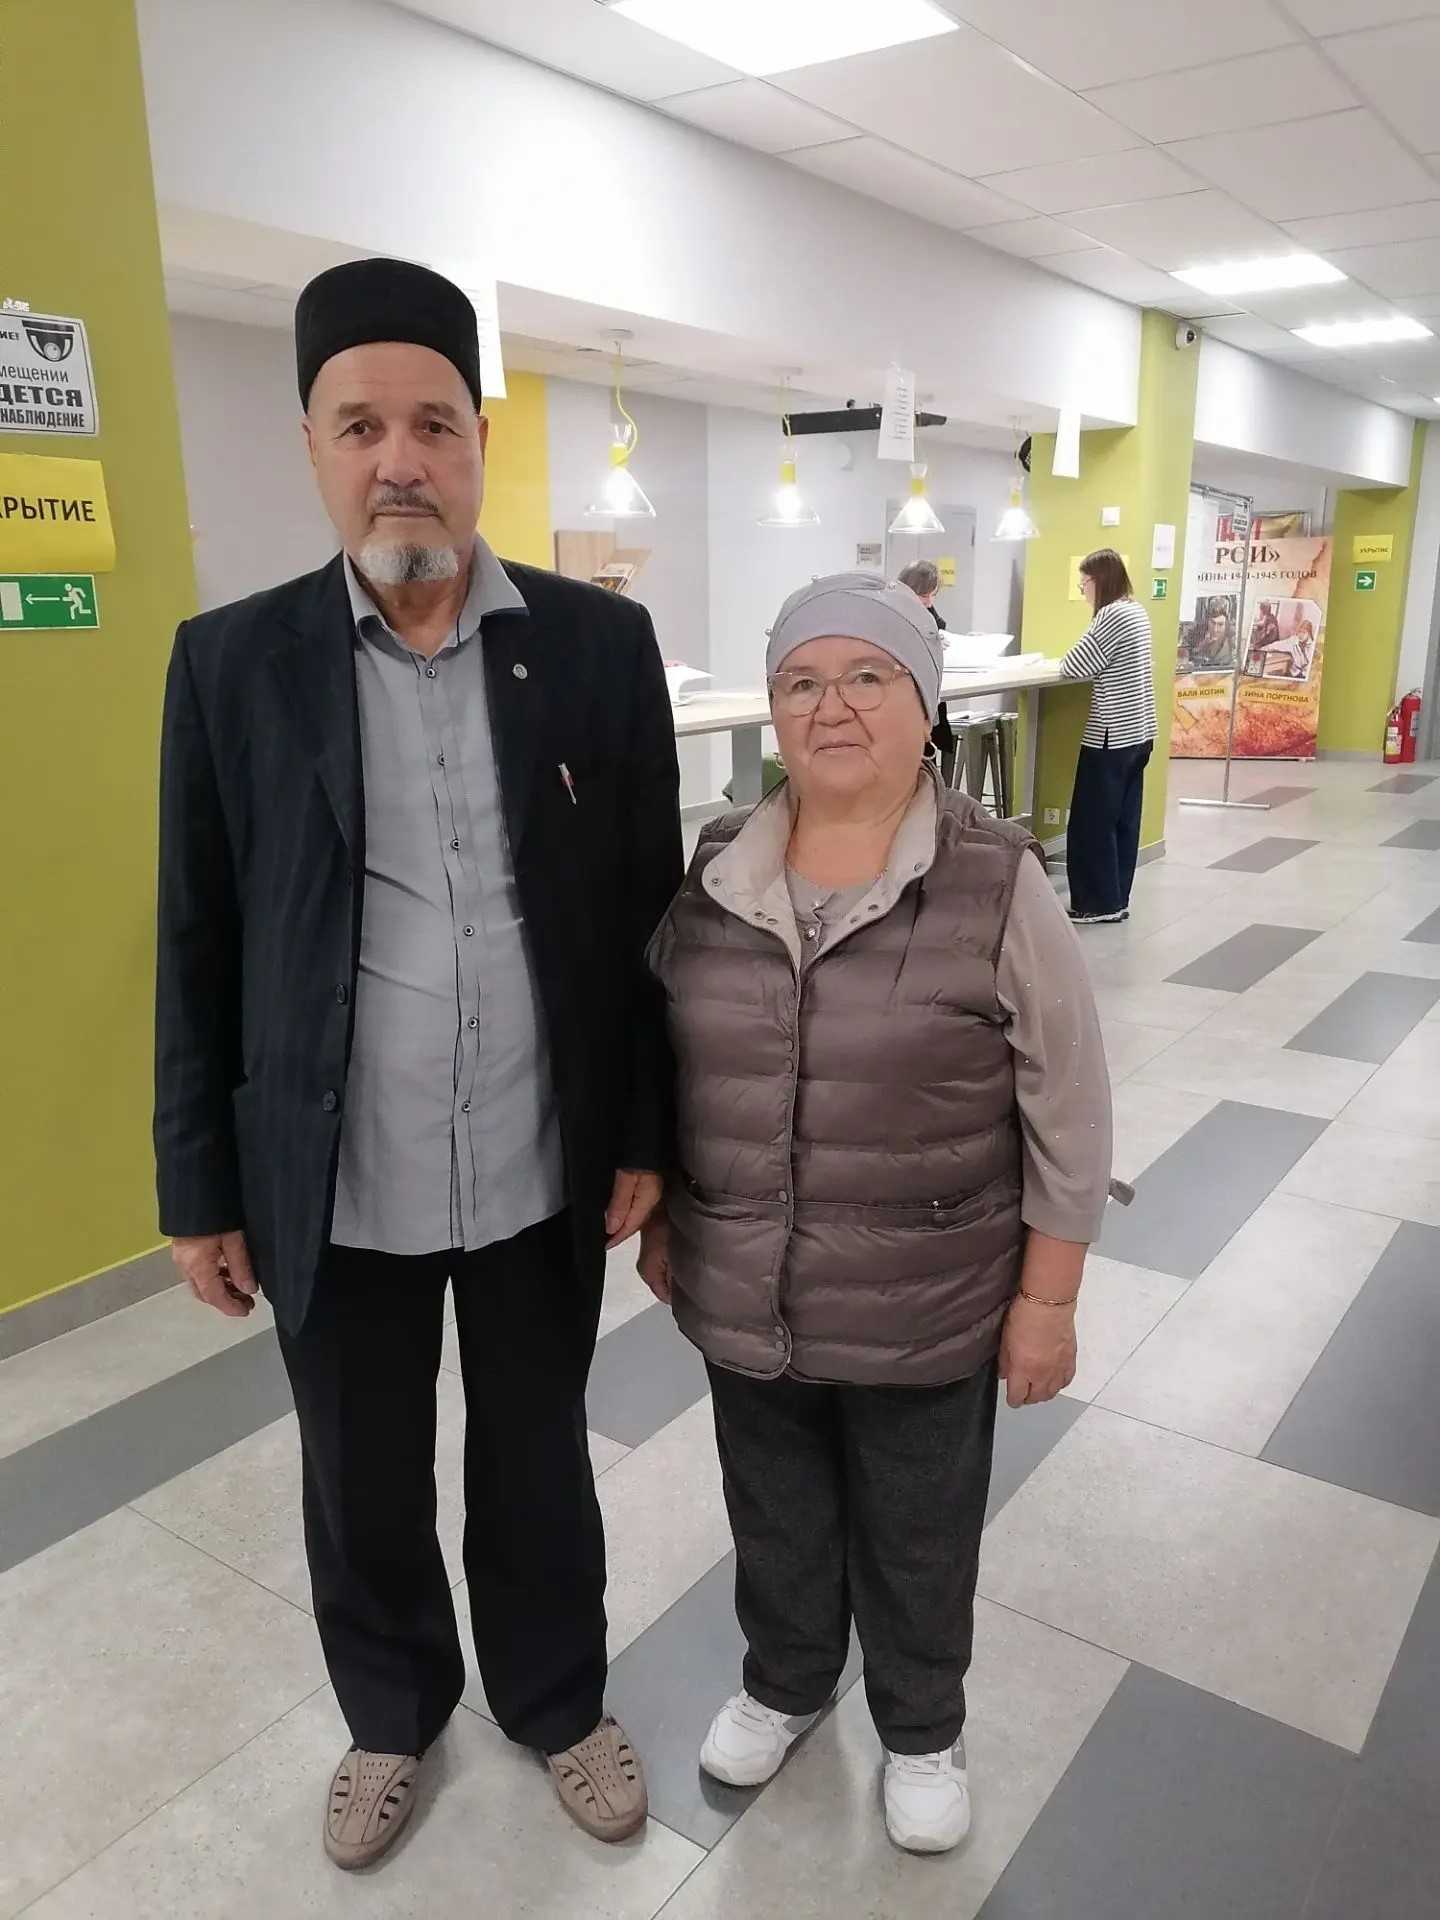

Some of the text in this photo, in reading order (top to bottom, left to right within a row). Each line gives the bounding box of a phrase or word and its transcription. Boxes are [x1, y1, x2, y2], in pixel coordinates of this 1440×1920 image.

[0, 383, 84, 408] ДЕТСЯ
[0, 408, 85, 428] НАБЛЮДЕНИЕ
[0, 496, 96, 522] РЫТИЕ
[1177, 688, 1225, 698] ВАЛЯ КОТИК
[1242, 691, 1309, 703] ЗИНА ПОРТНОВА
